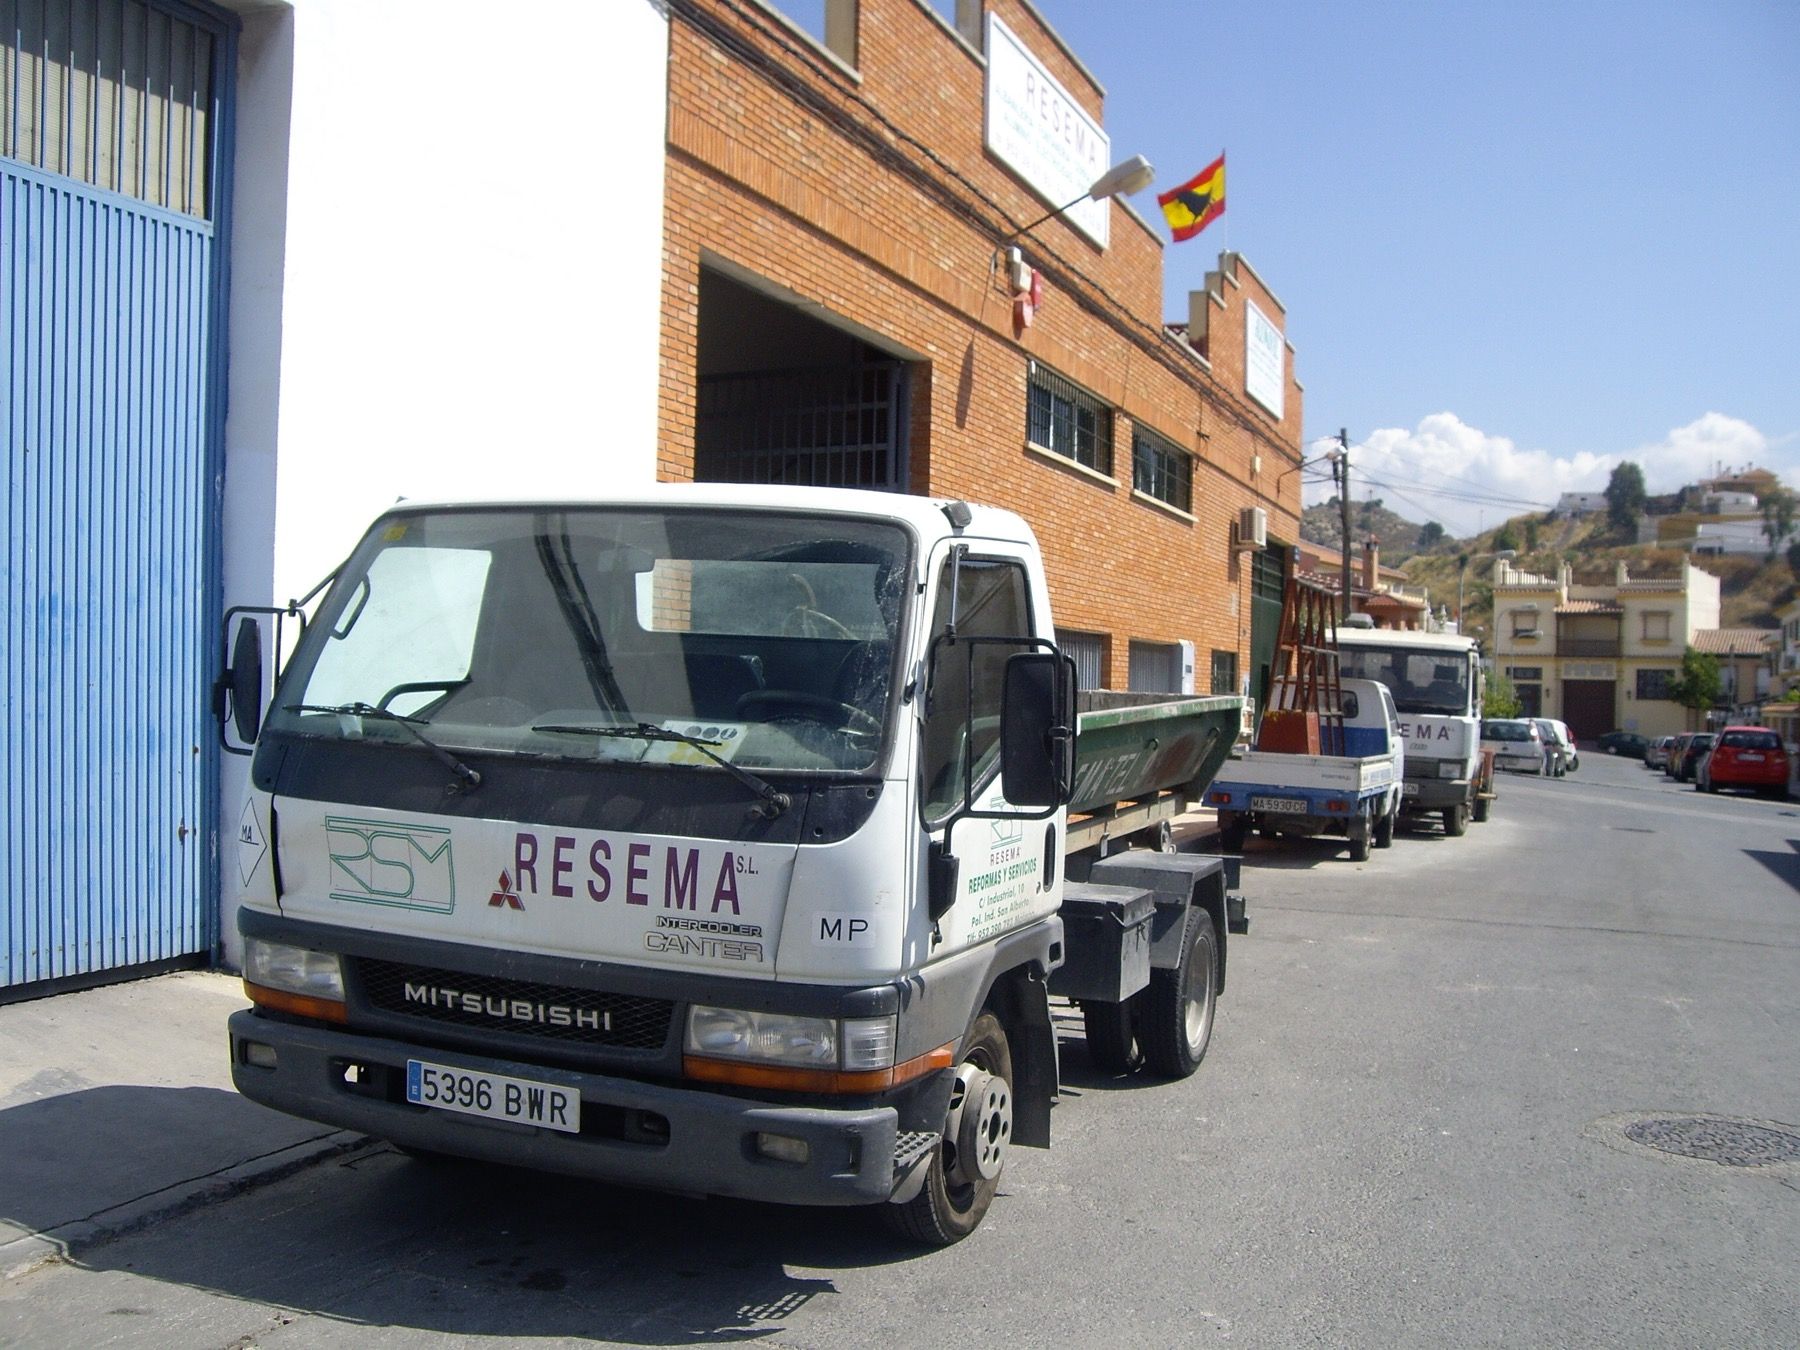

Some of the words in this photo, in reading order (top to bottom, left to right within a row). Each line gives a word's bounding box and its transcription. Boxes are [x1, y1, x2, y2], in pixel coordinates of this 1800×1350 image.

[1026, 71, 1097, 166] RESEMA
[515, 832, 741, 915] RESEMA
[736, 855, 759, 875] S.L.
[990, 846, 1021, 867] RESEMA
[968, 869, 1002, 895] REFORMAS
[1008, 857, 1037, 881] SERVICIOS
[656, 915, 763, 938] INTERCOOLER
[819, 917, 869, 942] MP
[643, 930, 764, 963] CANTER
[404, 982, 611, 1031] MITSUBISHI
[423, 1068, 492, 1111] 5396
[505, 1083, 568, 1126] BWR
